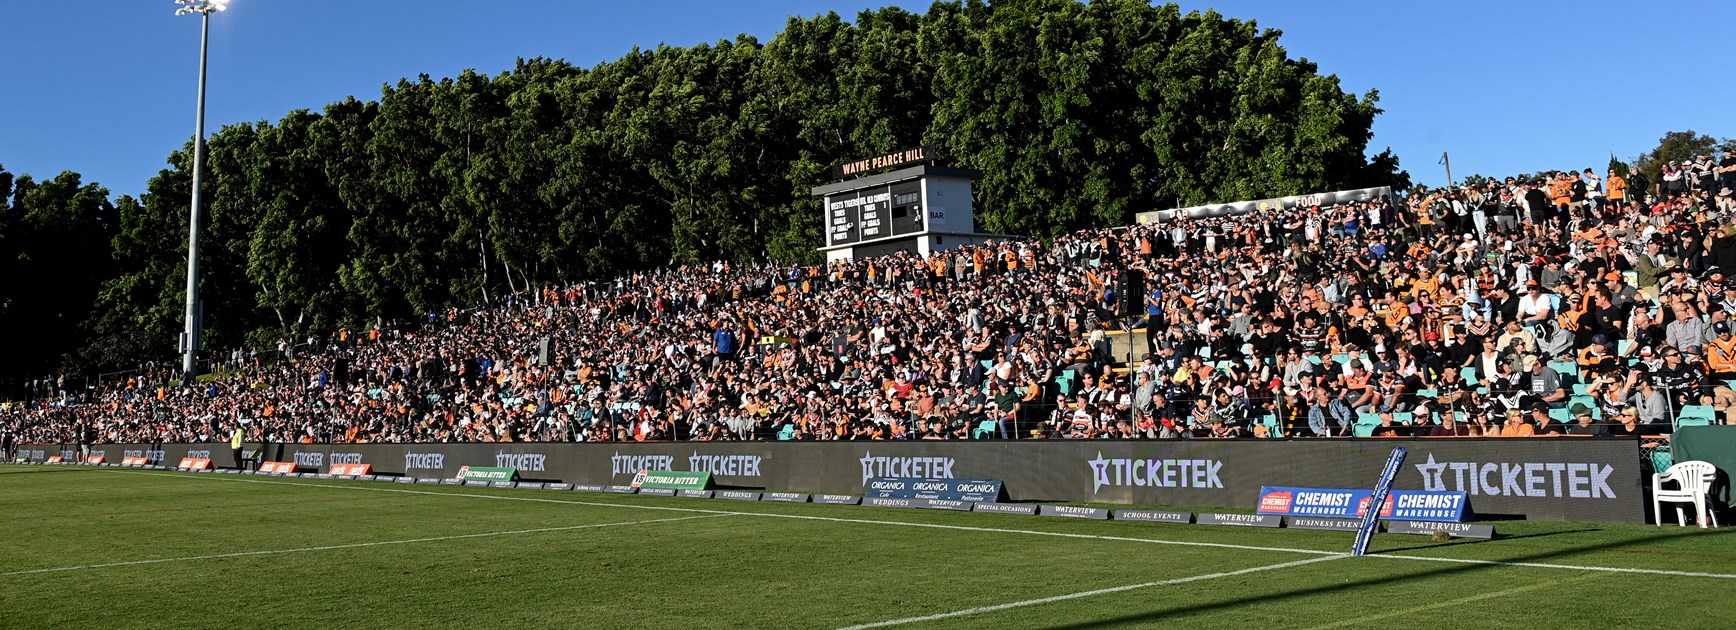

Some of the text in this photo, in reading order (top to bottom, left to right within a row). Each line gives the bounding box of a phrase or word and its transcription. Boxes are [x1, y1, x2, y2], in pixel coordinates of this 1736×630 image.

[843, 148, 924, 175] WAYNE PEARCE HILL
[1296, 195, 1321, 208] FOOD
[930, 211, 944, 219] BAR
[411, 453, 445, 470] TICKETEK
[504, 453, 547, 472] TICKETEK
[622, 455, 674, 474] TICKETEK
[701, 455, 762, 477] TICKETEK
[331, 465, 365, 475] neds neds
[874, 456, 955, 479] TICKETEK
[1111, 458, 1224, 489] TICKETEK
[635, 474, 699, 485] VB VICTORIA BITTER
[1449, 462, 1617, 499] TICKETEK
[871, 481, 905, 490] ORGANICA
[912, 482, 948, 491] ORGANICA
[957, 483, 995, 493] ORGANICA
[928, 499, 962, 507] WATERVIEW
[1261, 498, 1291, 506] CHEMIST
[1295, 492, 1353, 507] CHEMIST
[1397, 494, 1462, 509] CHEMIST
[977, 504, 1032, 513] SPECIAL OCCASIONS
[1055, 505, 1096, 515] WATERVIEW
[1293, 506, 1347, 515] WAREHOUSE
[1396, 509, 1456, 518] WAREHOUSE
[1122, 511, 1182, 520] SCHOOL EVENTS
[1214, 513, 1264, 523] WATERVIEW
[1295, 519, 1334, 527] BUSINESS
[1409, 521, 1471, 532] WATERVIEW
